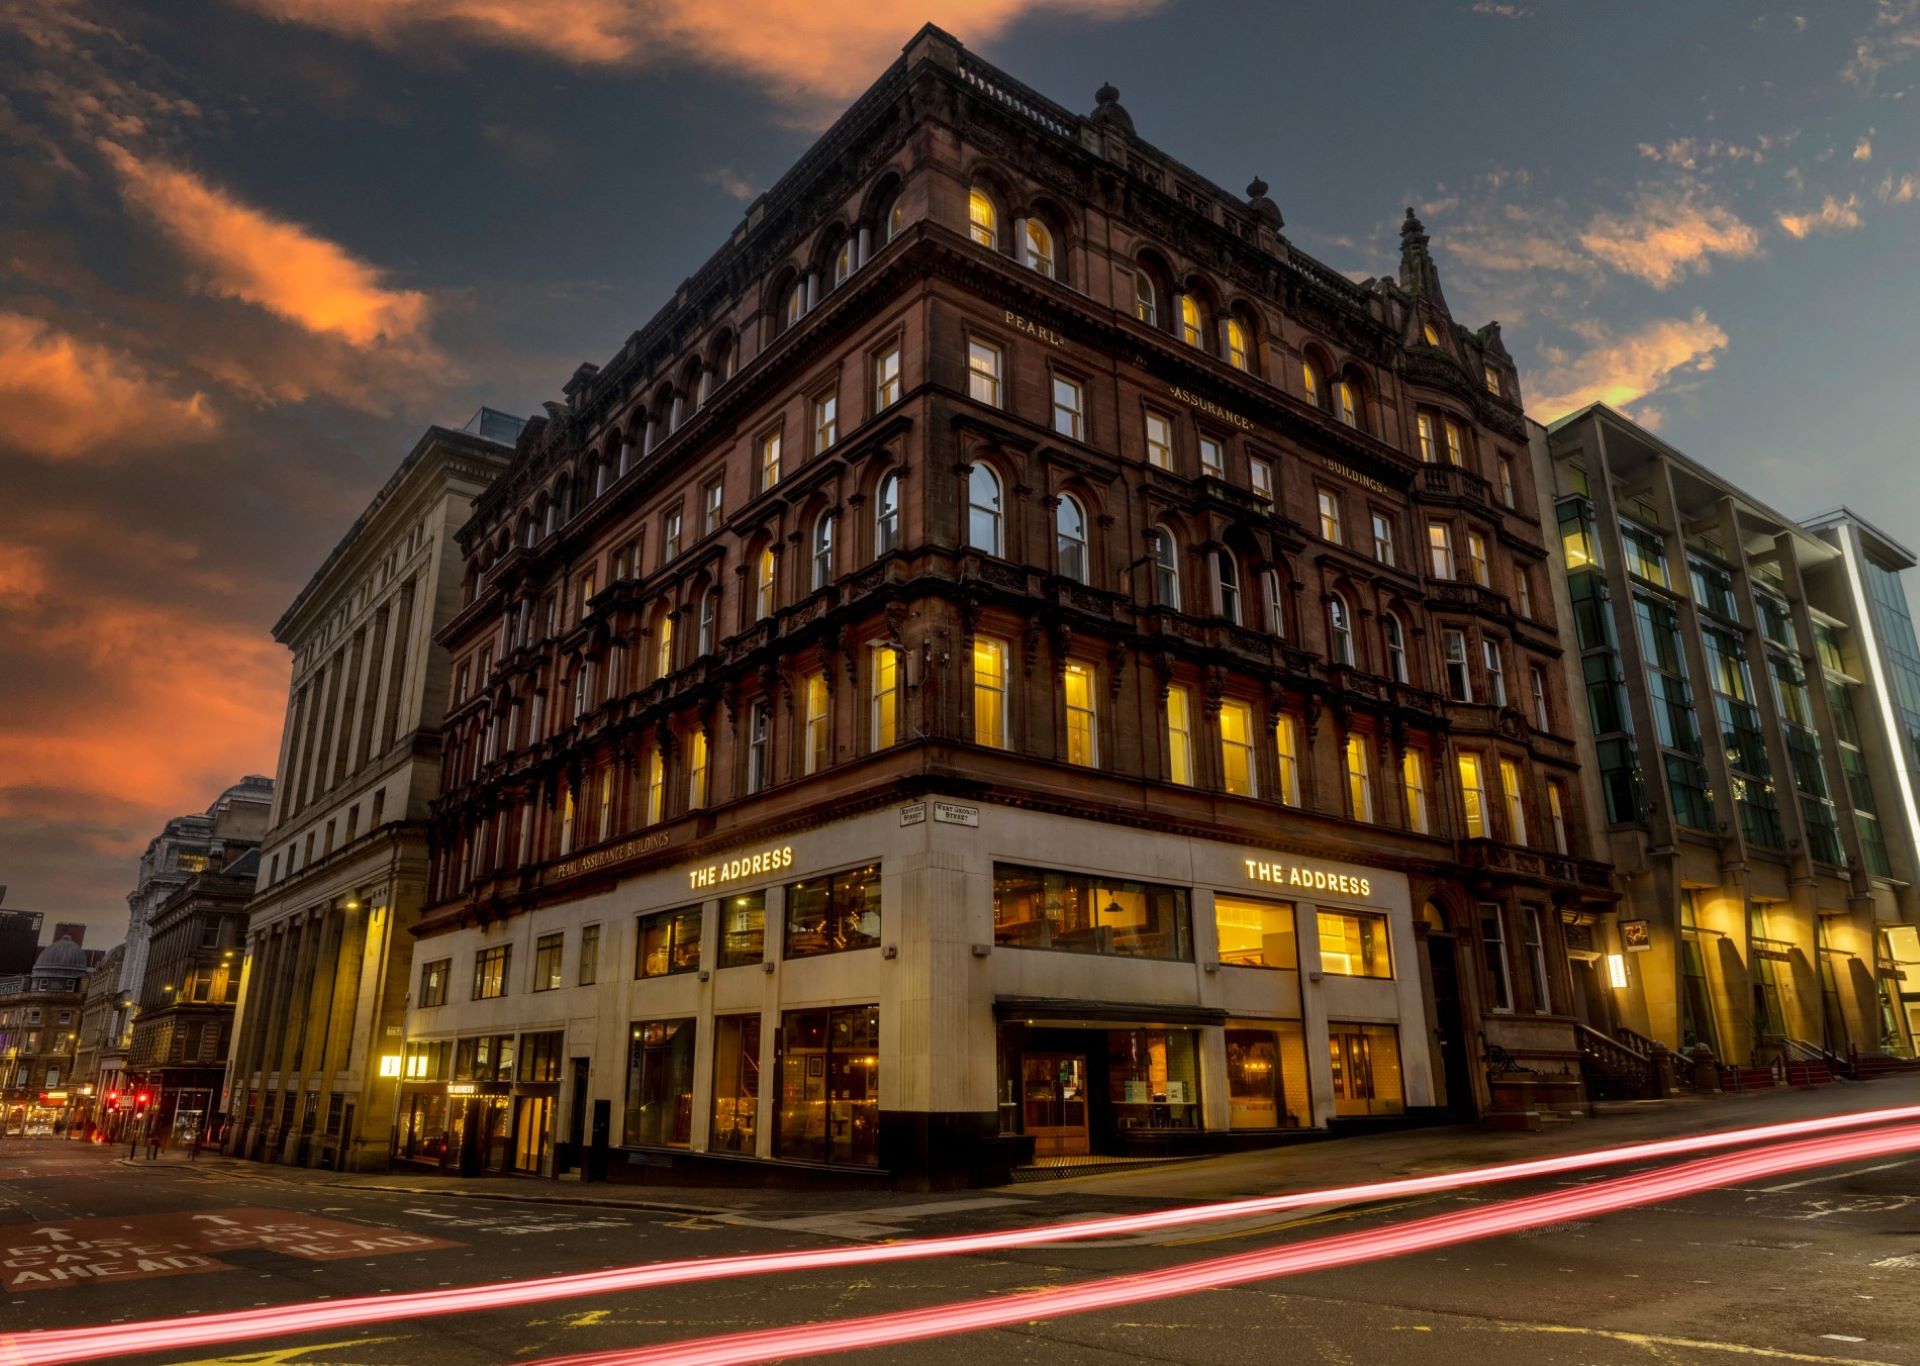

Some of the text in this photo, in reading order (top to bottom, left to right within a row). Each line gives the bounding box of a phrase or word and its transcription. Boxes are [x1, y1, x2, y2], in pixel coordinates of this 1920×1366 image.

[1005, 310, 1383, 493] PEARL ASSURANCE BUILDINGS
[558, 831, 669, 877] PEARL ASSURANCE BUILDINGS
[690, 846, 792, 889] THE ADDRESS
[1245, 860, 1370, 896] THE ADDRESS
[8, 1238, 132, 1256] BUS
[11, 1255, 210, 1285] AHEAD
